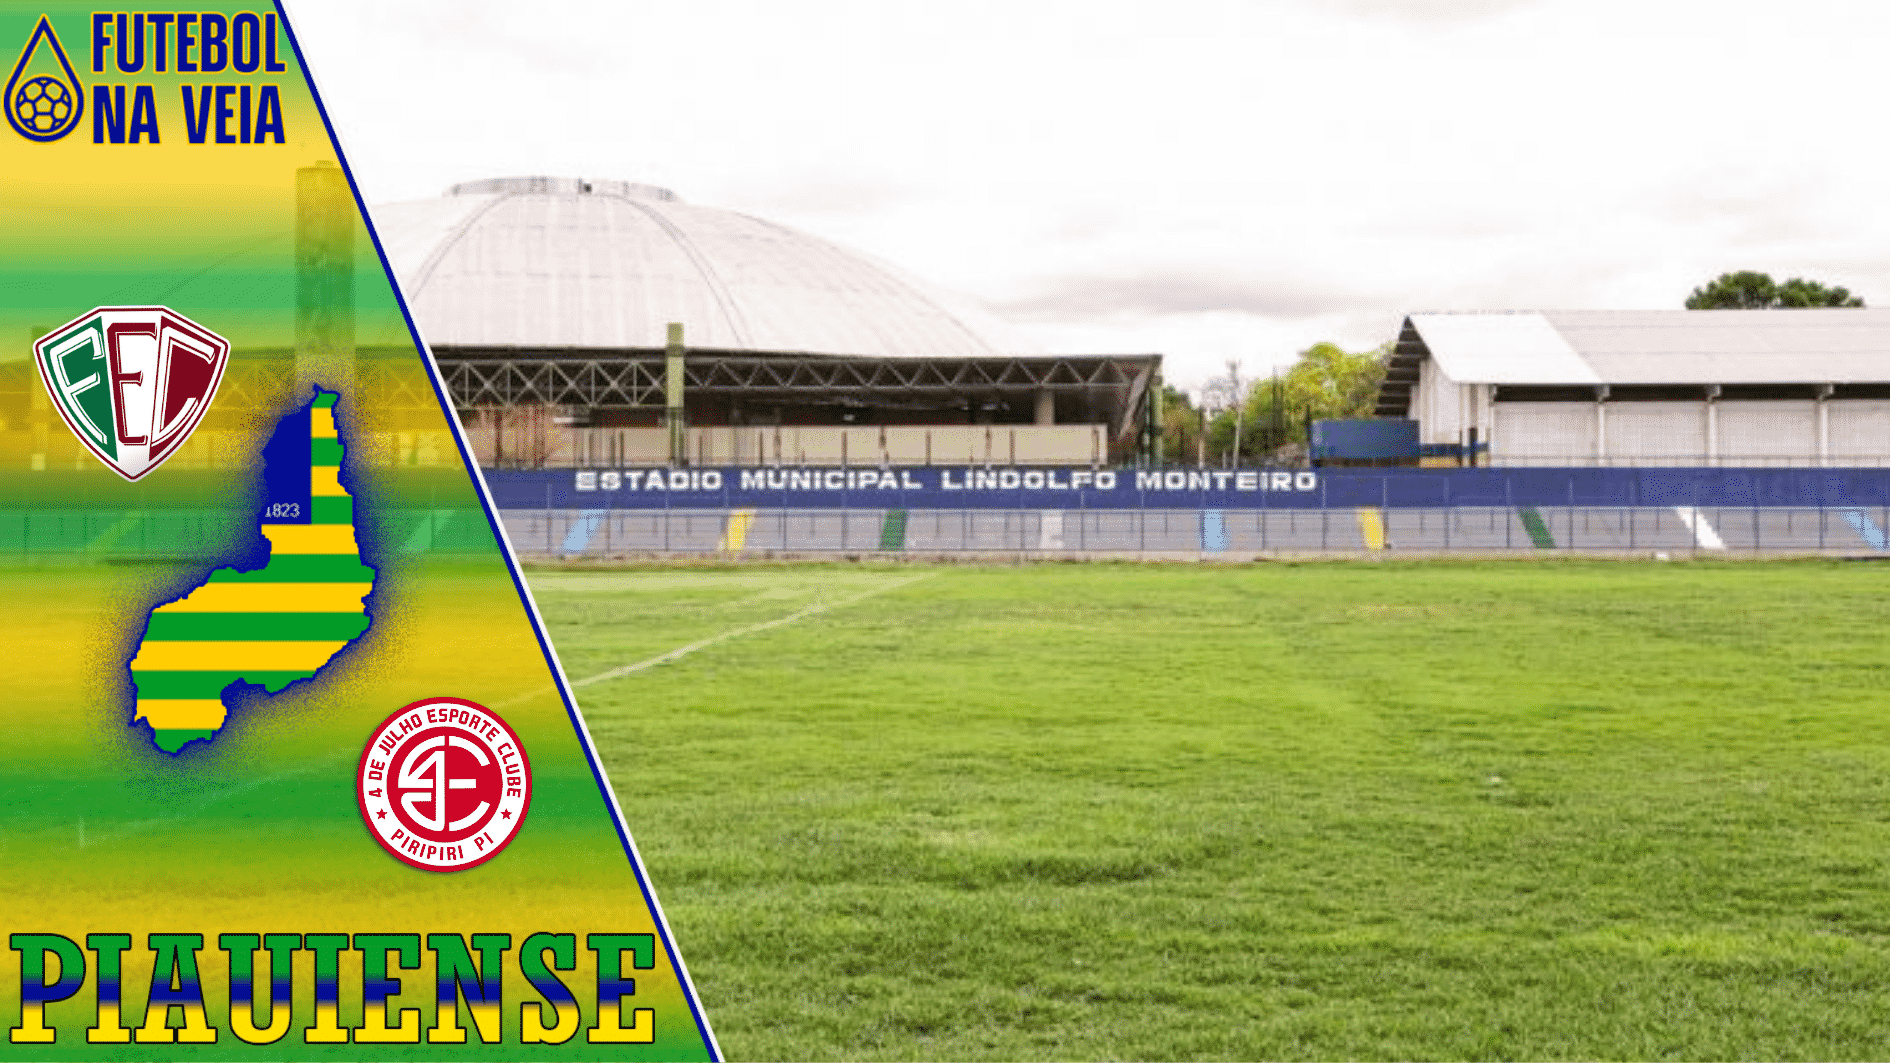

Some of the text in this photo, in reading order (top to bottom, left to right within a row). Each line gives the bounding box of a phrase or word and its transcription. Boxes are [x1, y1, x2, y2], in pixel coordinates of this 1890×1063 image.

[575, 470, 1317, 491] ESTADIO MUNICIPAL LINDOLFO MONTEIRO
